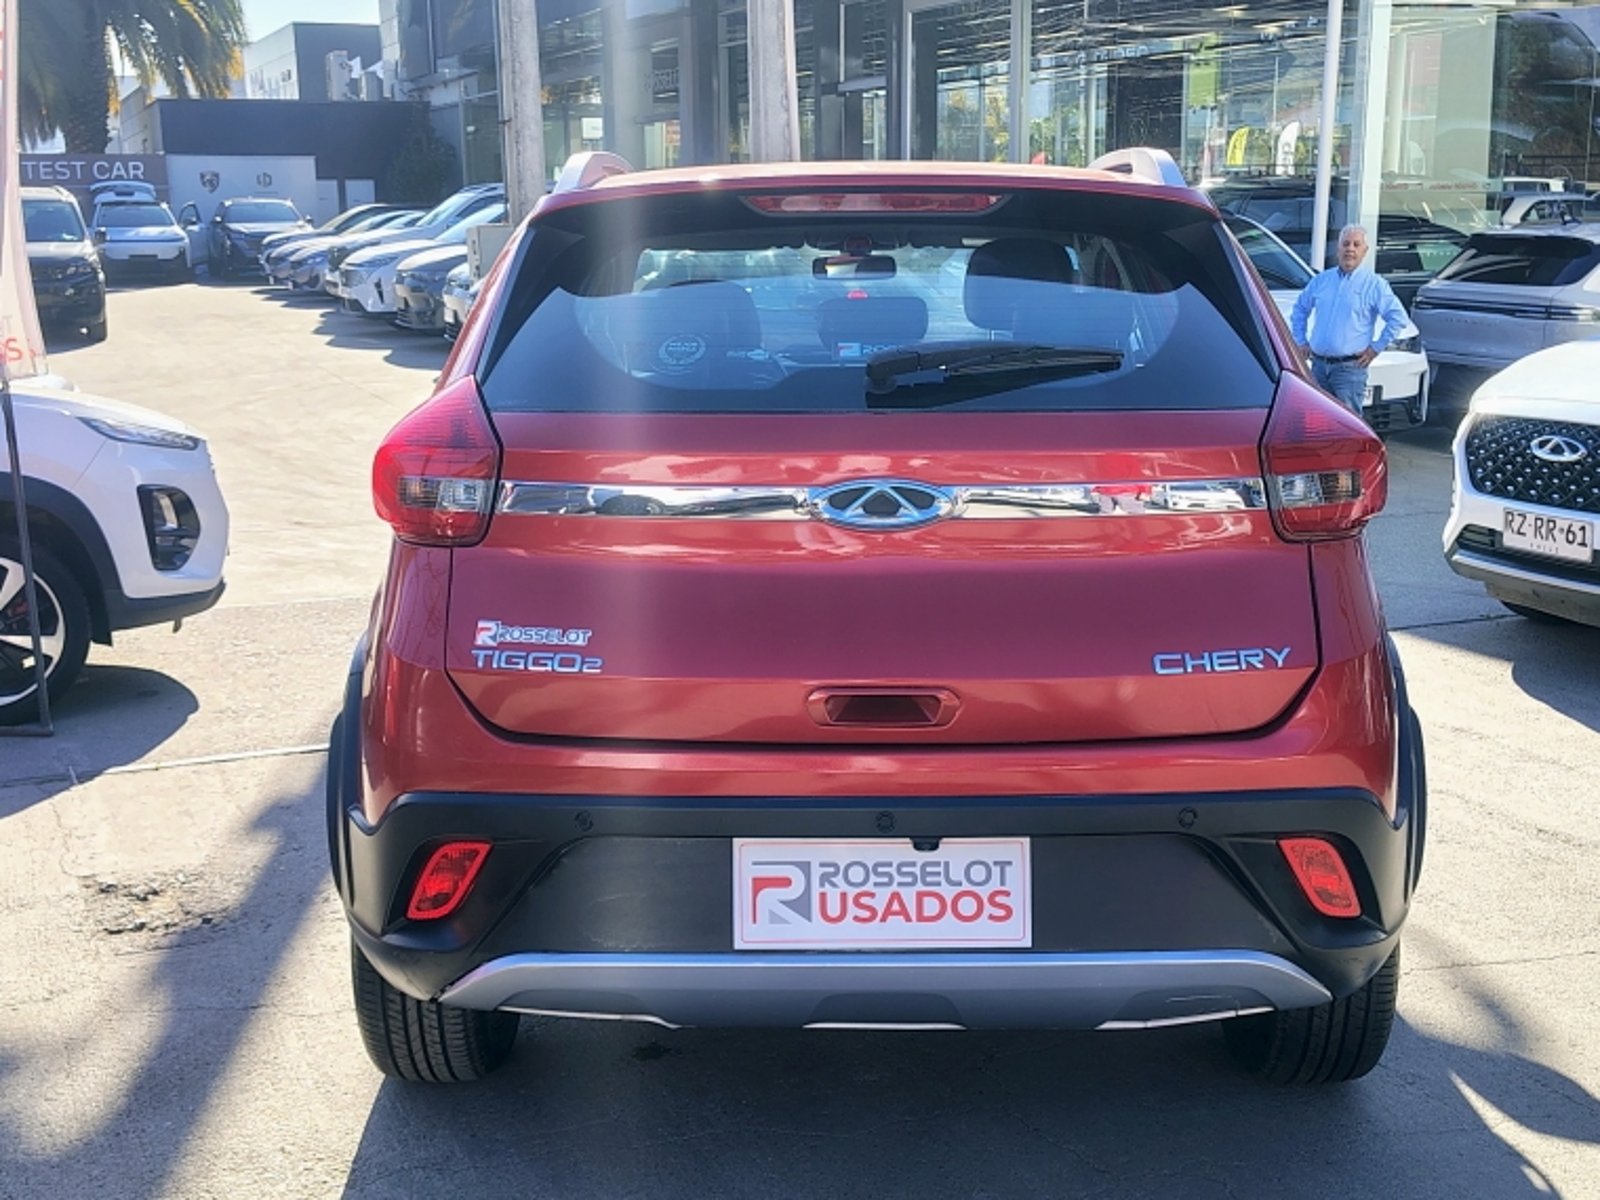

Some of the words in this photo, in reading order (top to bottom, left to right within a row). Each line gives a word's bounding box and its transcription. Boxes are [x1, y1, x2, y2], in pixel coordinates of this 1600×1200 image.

[21, 161, 87, 180] TEST
[92, 161, 145, 180] CAR
[500, 627, 591, 644] ROSSELOT
[1153, 647, 1292, 675] CHERY
[818, 860, 1013, 888] ROSSELOT
[818, 890, 1014, 925] USADOS
